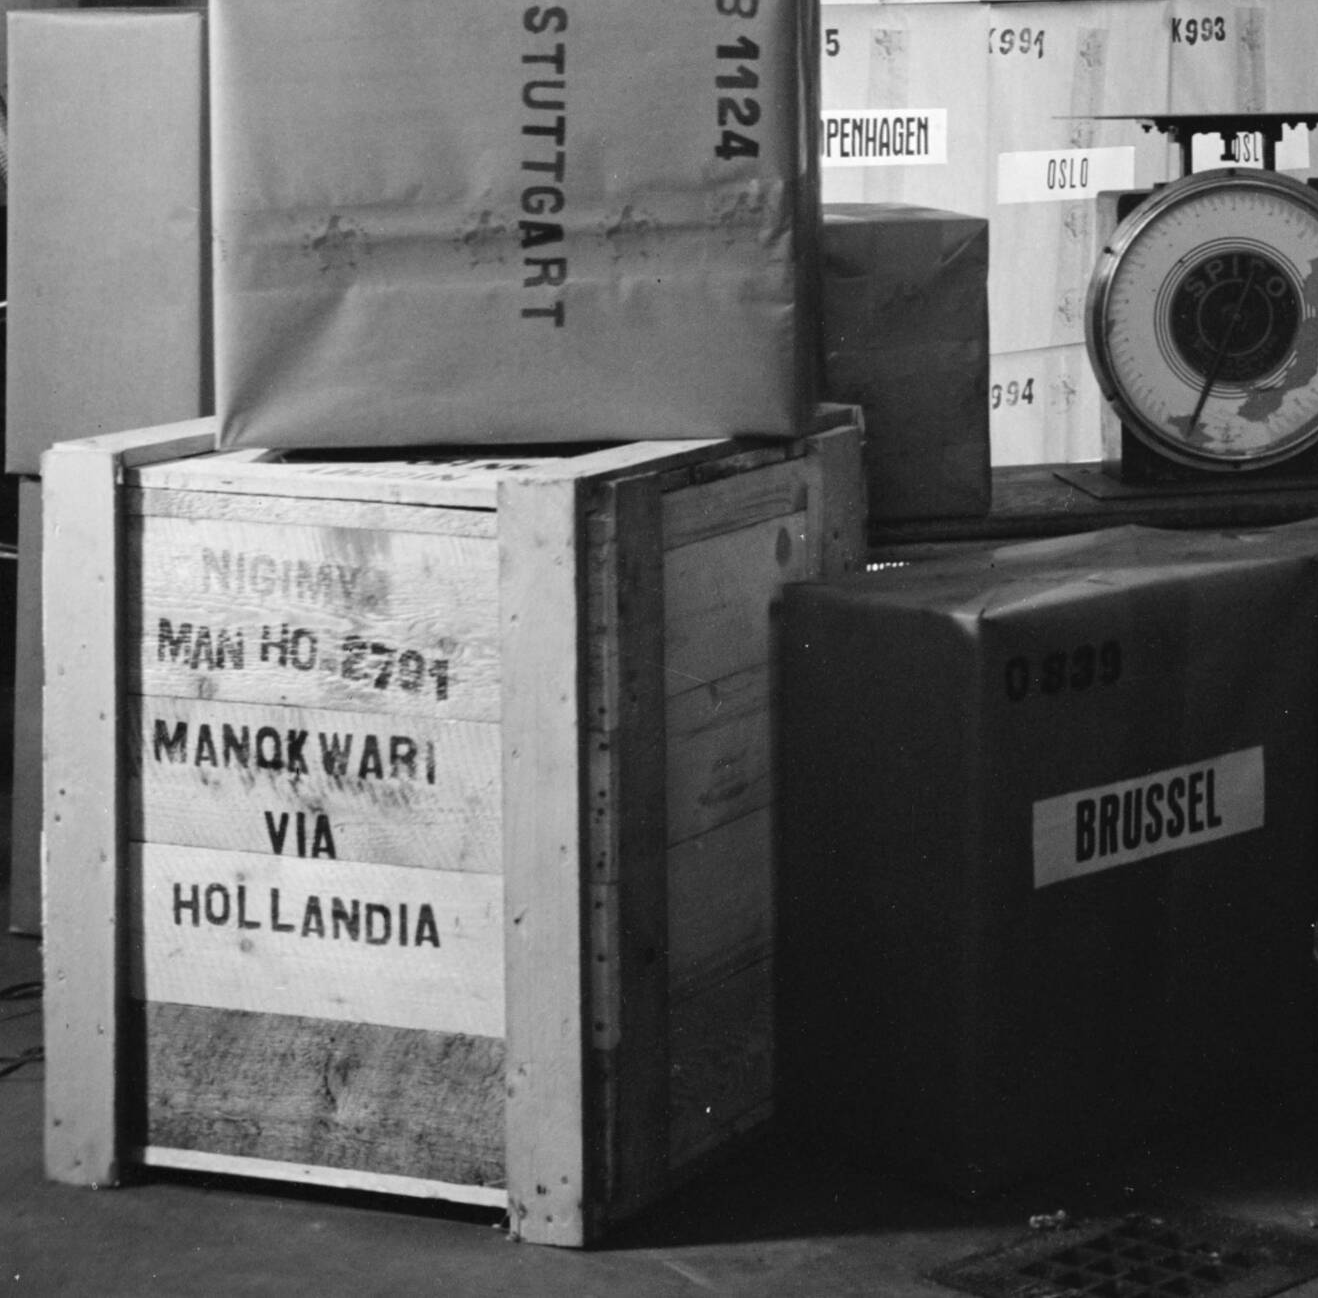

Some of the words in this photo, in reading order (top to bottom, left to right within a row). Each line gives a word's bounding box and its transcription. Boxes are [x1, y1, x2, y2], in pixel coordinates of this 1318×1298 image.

[714, 35, 761, 161] 1124
[519, 5, 568, 328] STUTTGART
[1047, 158, 1088, 189] OSLO
[157, 617, 245, 670] MAN
[265, 811, 337, 859] VIA
[1076, 768, 1221, 863] BRUSSEL
[173, 882, 440, 948] HOLLANDIA
